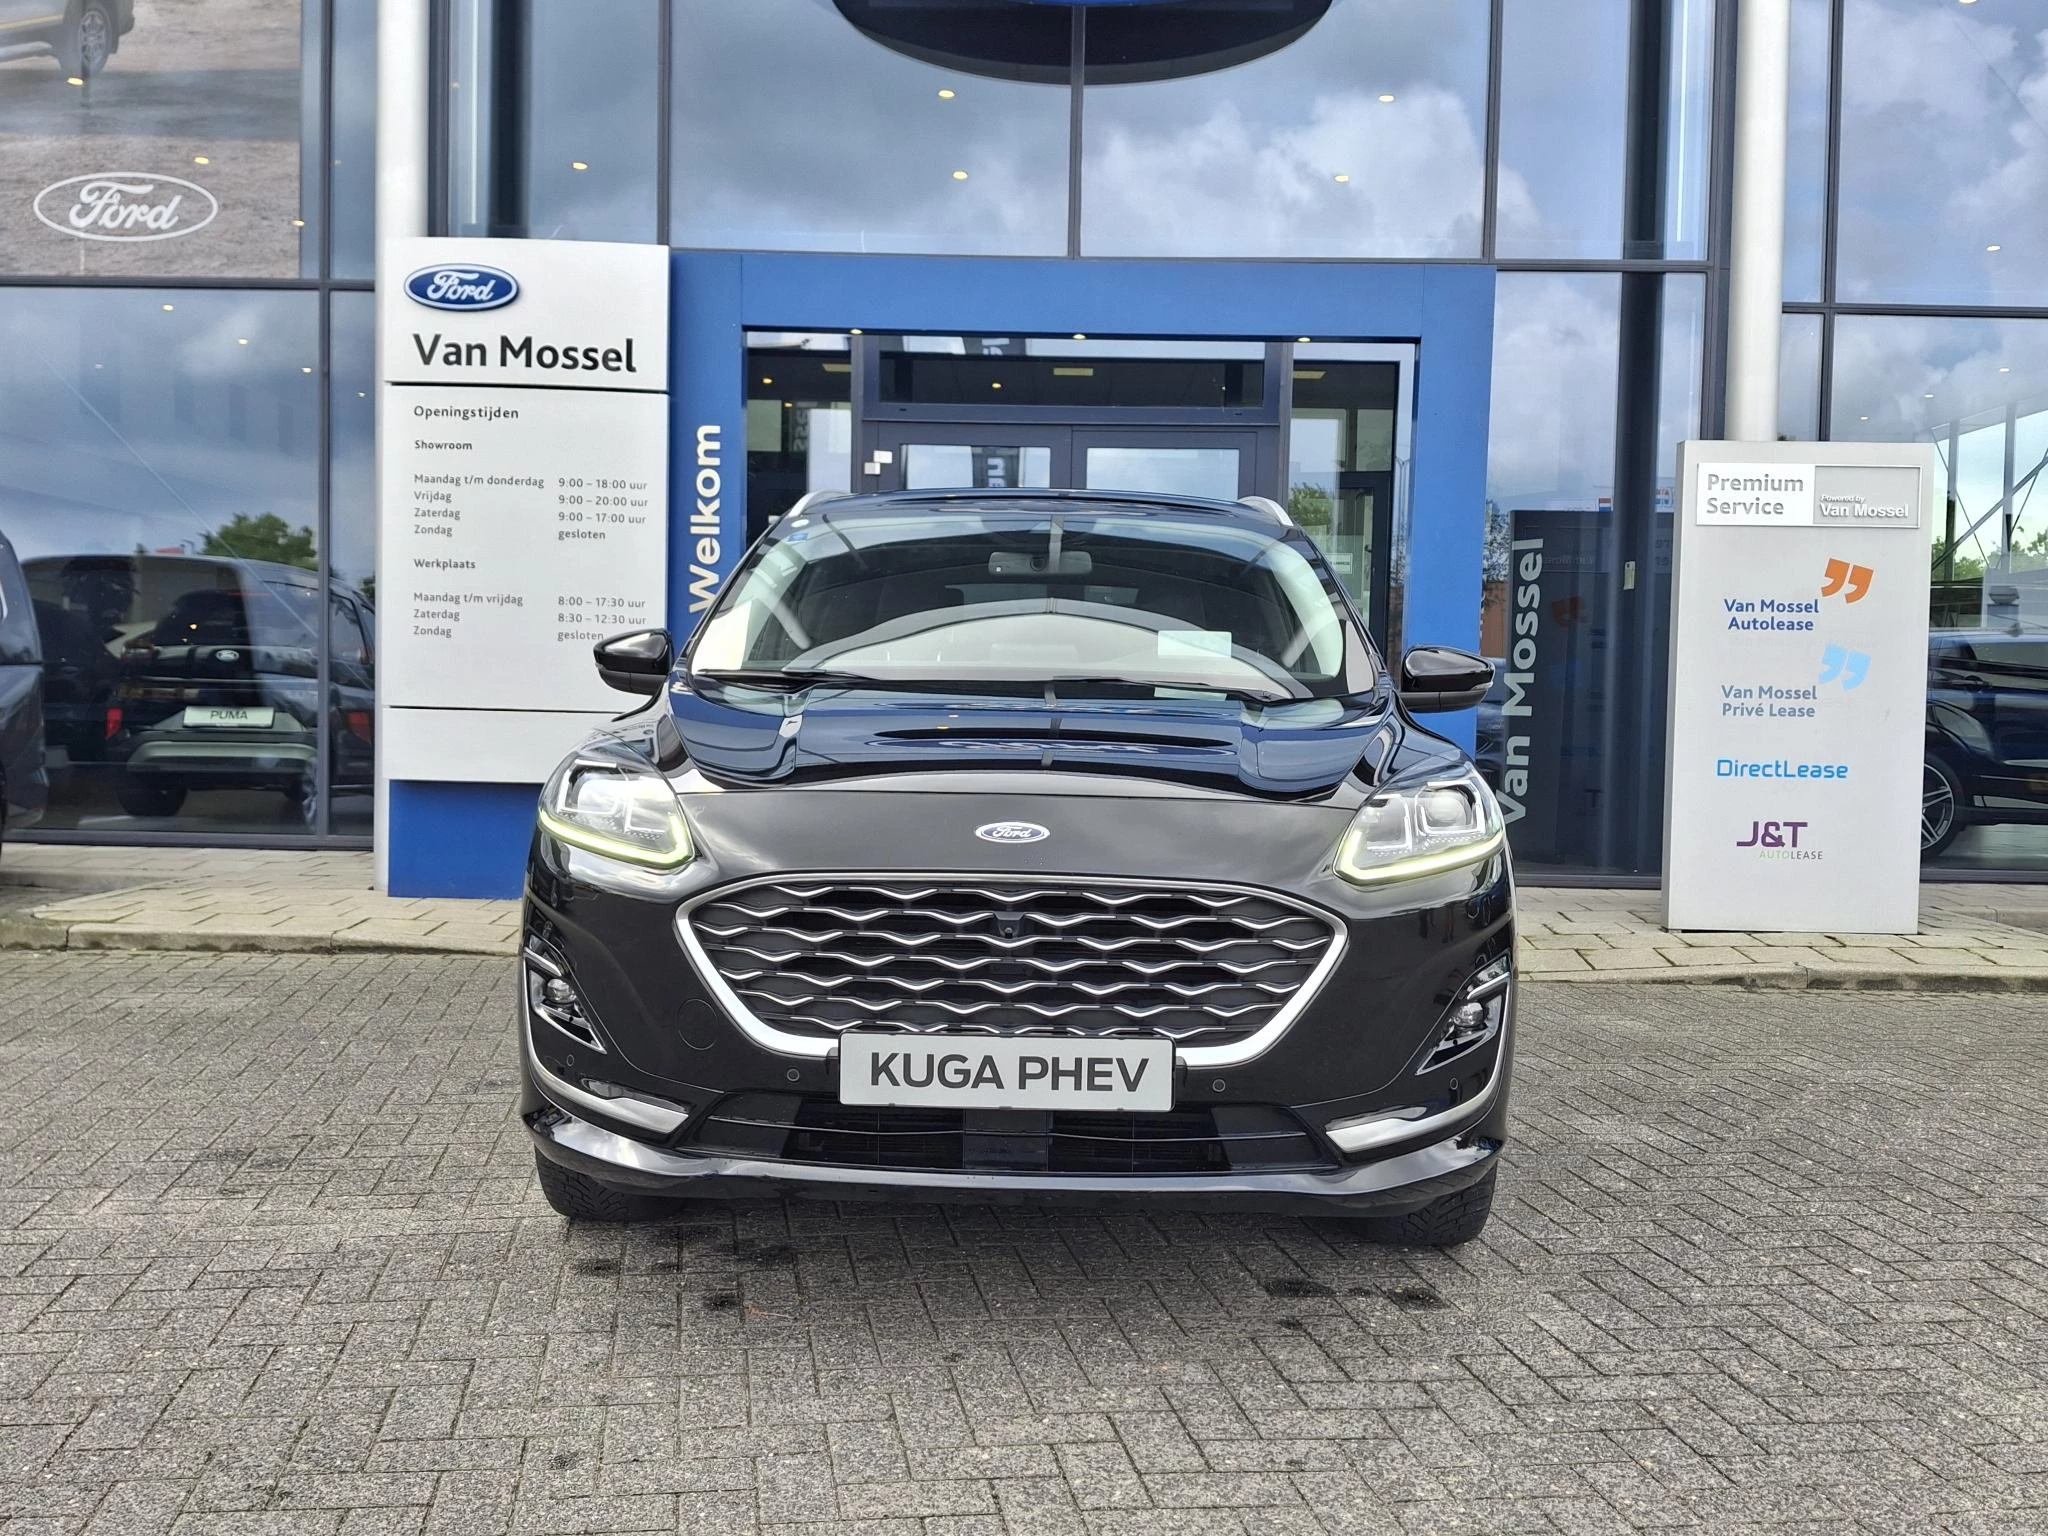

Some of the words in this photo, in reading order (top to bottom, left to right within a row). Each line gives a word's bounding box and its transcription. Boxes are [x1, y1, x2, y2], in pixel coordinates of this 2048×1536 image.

[69, 181, 183, 230] Ford
[426, 270, 495, 301] Ford
[413, 333, 487, 367] Van
[500, 335, 638, 373] Mossel
[414, 405, 519, 421] Openingstijden
[414, 439, 473, 451] Showroom
[414, 474, 461, 487] Maandag
[464, 475, 484, 485] t/m
[487, 475, 545, 489] donderdag
[558, 477, 584, 488] 9:00
[595, 479, 627, 489] 18:00
[629, 482, 648, 490] uur
[1707, 473, 1804, 492] Premium
[414, 491, 452, 503] Vrijdag
[558, 494, 583, 505] 9:00
[595, 495, 628, 506] 20:00
[630, 498, 649, 507] uur
[1706, 497, 1785, 516] Service
[1855, 495, 1866, 504] by
[414, 507, 461, 521] Zaterdag
[558, 511, 583, 522] 9:00
[595, 512, 626, 523] 17:00
[628, 516, 647, 524] uur
[1820, 502, 1850, 517] Van
[1854, 503, 1910, 518] Mossel
[688, 424, 722, 614] Welkom
[414, 525, 453, 538] Zondag
[558, 528, 606, 541] gesloten
[413, 559, 476, 571] Werkplaats
[413, 592, 461, 605] Maandag
[463, 593, 484, 604] t/m
[486, 594, 524, 607] vrijdag
[558, 596, 583, 606] 8:00
[595, 597, 625, 608] 17:30
[627, 600, 646, 608] uur
[1724, 599, 1755, 613] Van
[1760, 599, 1819, 613] Mossel
[413, 608, 460, 622] Zaterdag
[558, 613, 583, 623] 8:30
[594, 614, 625, 624] 12:30
[628, 616, 647, 625] uur
[1728, 616, 1814, 631] Autolease
[413, 625, 452, 639] Zondag
[557, 630, 604, 642] gesloten
[1501, 538, 1544, 717] Mossel
[1721, 685, 1753, 699] Van
[1758, 685, 1818, 700] Mossel
[210, 710, 248, 720] PUMA
[1722, 702, 1765, 717] Privé
[1769, 703, 1816, 717] Lease
[1716, 759, 1849, 779] DirectLease
[1495, 735, 1531, 825] Van
[992, 826, 1033, 838] Ford
[1736, 820, 1808, 848] J&T
[1758, 850, 1824, 861] AUTOLEASE
[870, 1052, 1005, 1090] KUGA
[1018, 1055, 1150, 1093] PHEV
